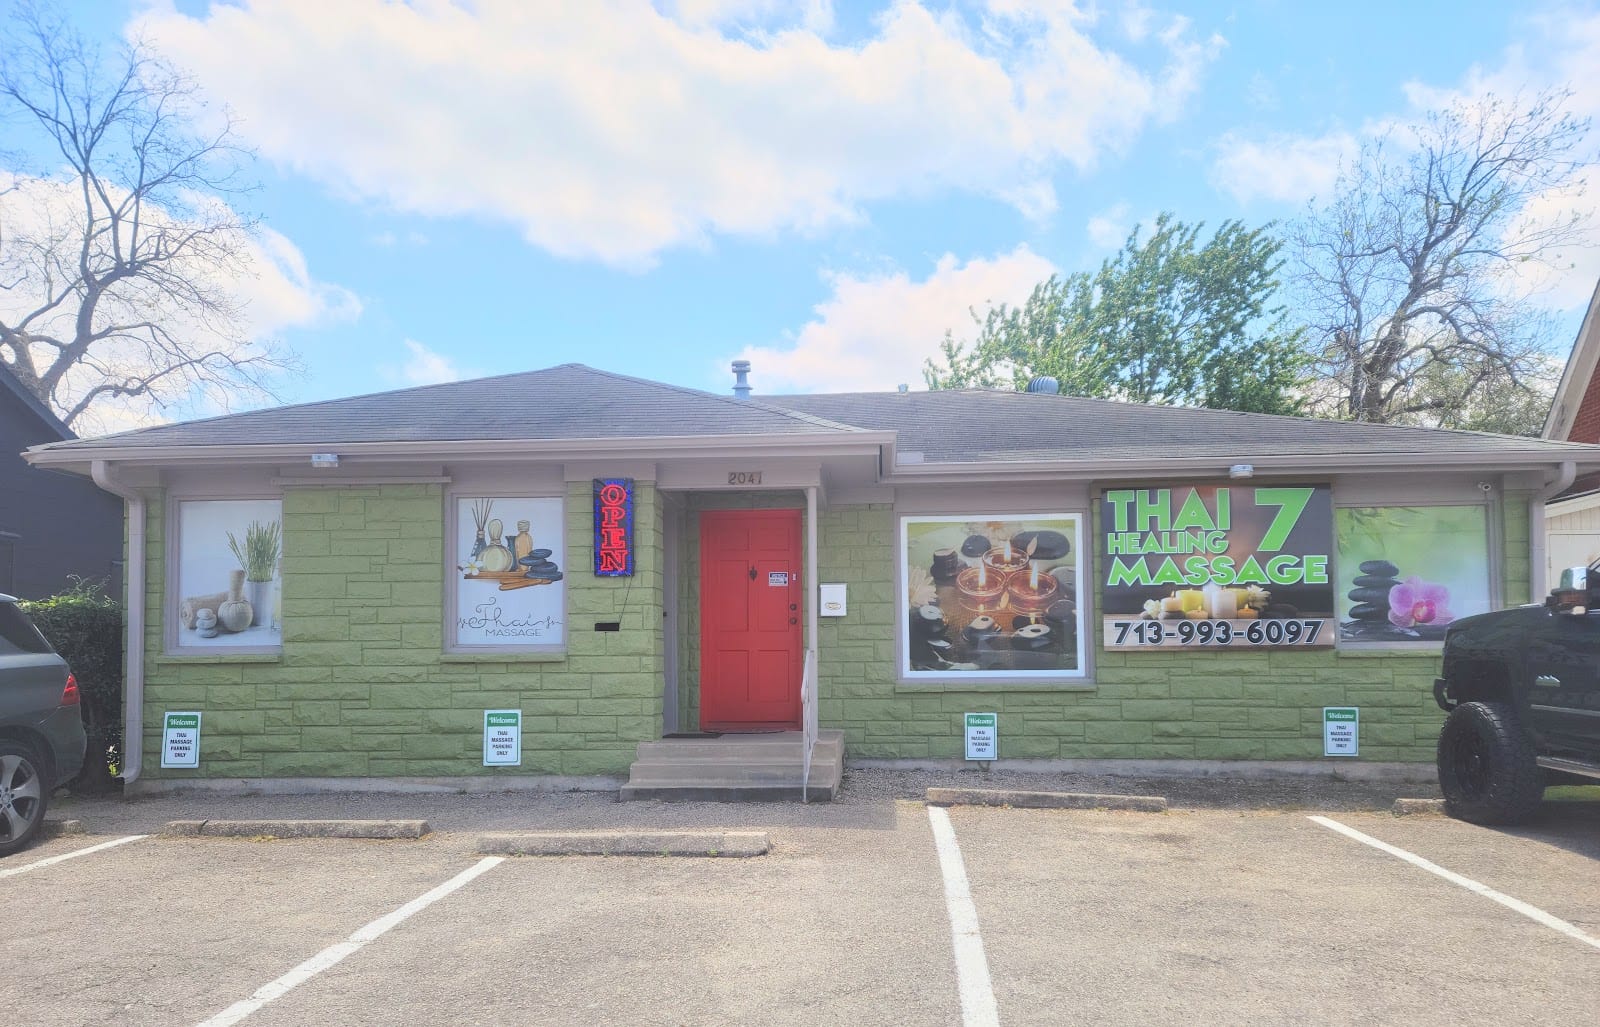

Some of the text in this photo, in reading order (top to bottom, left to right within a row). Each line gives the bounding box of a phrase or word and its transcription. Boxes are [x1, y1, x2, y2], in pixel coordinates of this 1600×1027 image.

[728, 471, 762, 485] 2041
[600, 484, 628, 572] OPEN
[1107, 487, 1315, 552] THAI 7
[1107, 531, 1229, 555] HEALING
[1107, 555, 1329, 587] MASSAGE
[464, 597, 550, 629] Thai
[485, 629, 543, 637] MASSAGE
[1114, 620, 1325, 645] 713-993-6097
[169, 718, 197, 726] Welcome
[488, 716, 517, 724] Welcome
[968, 717, 994, 725] Welcome
